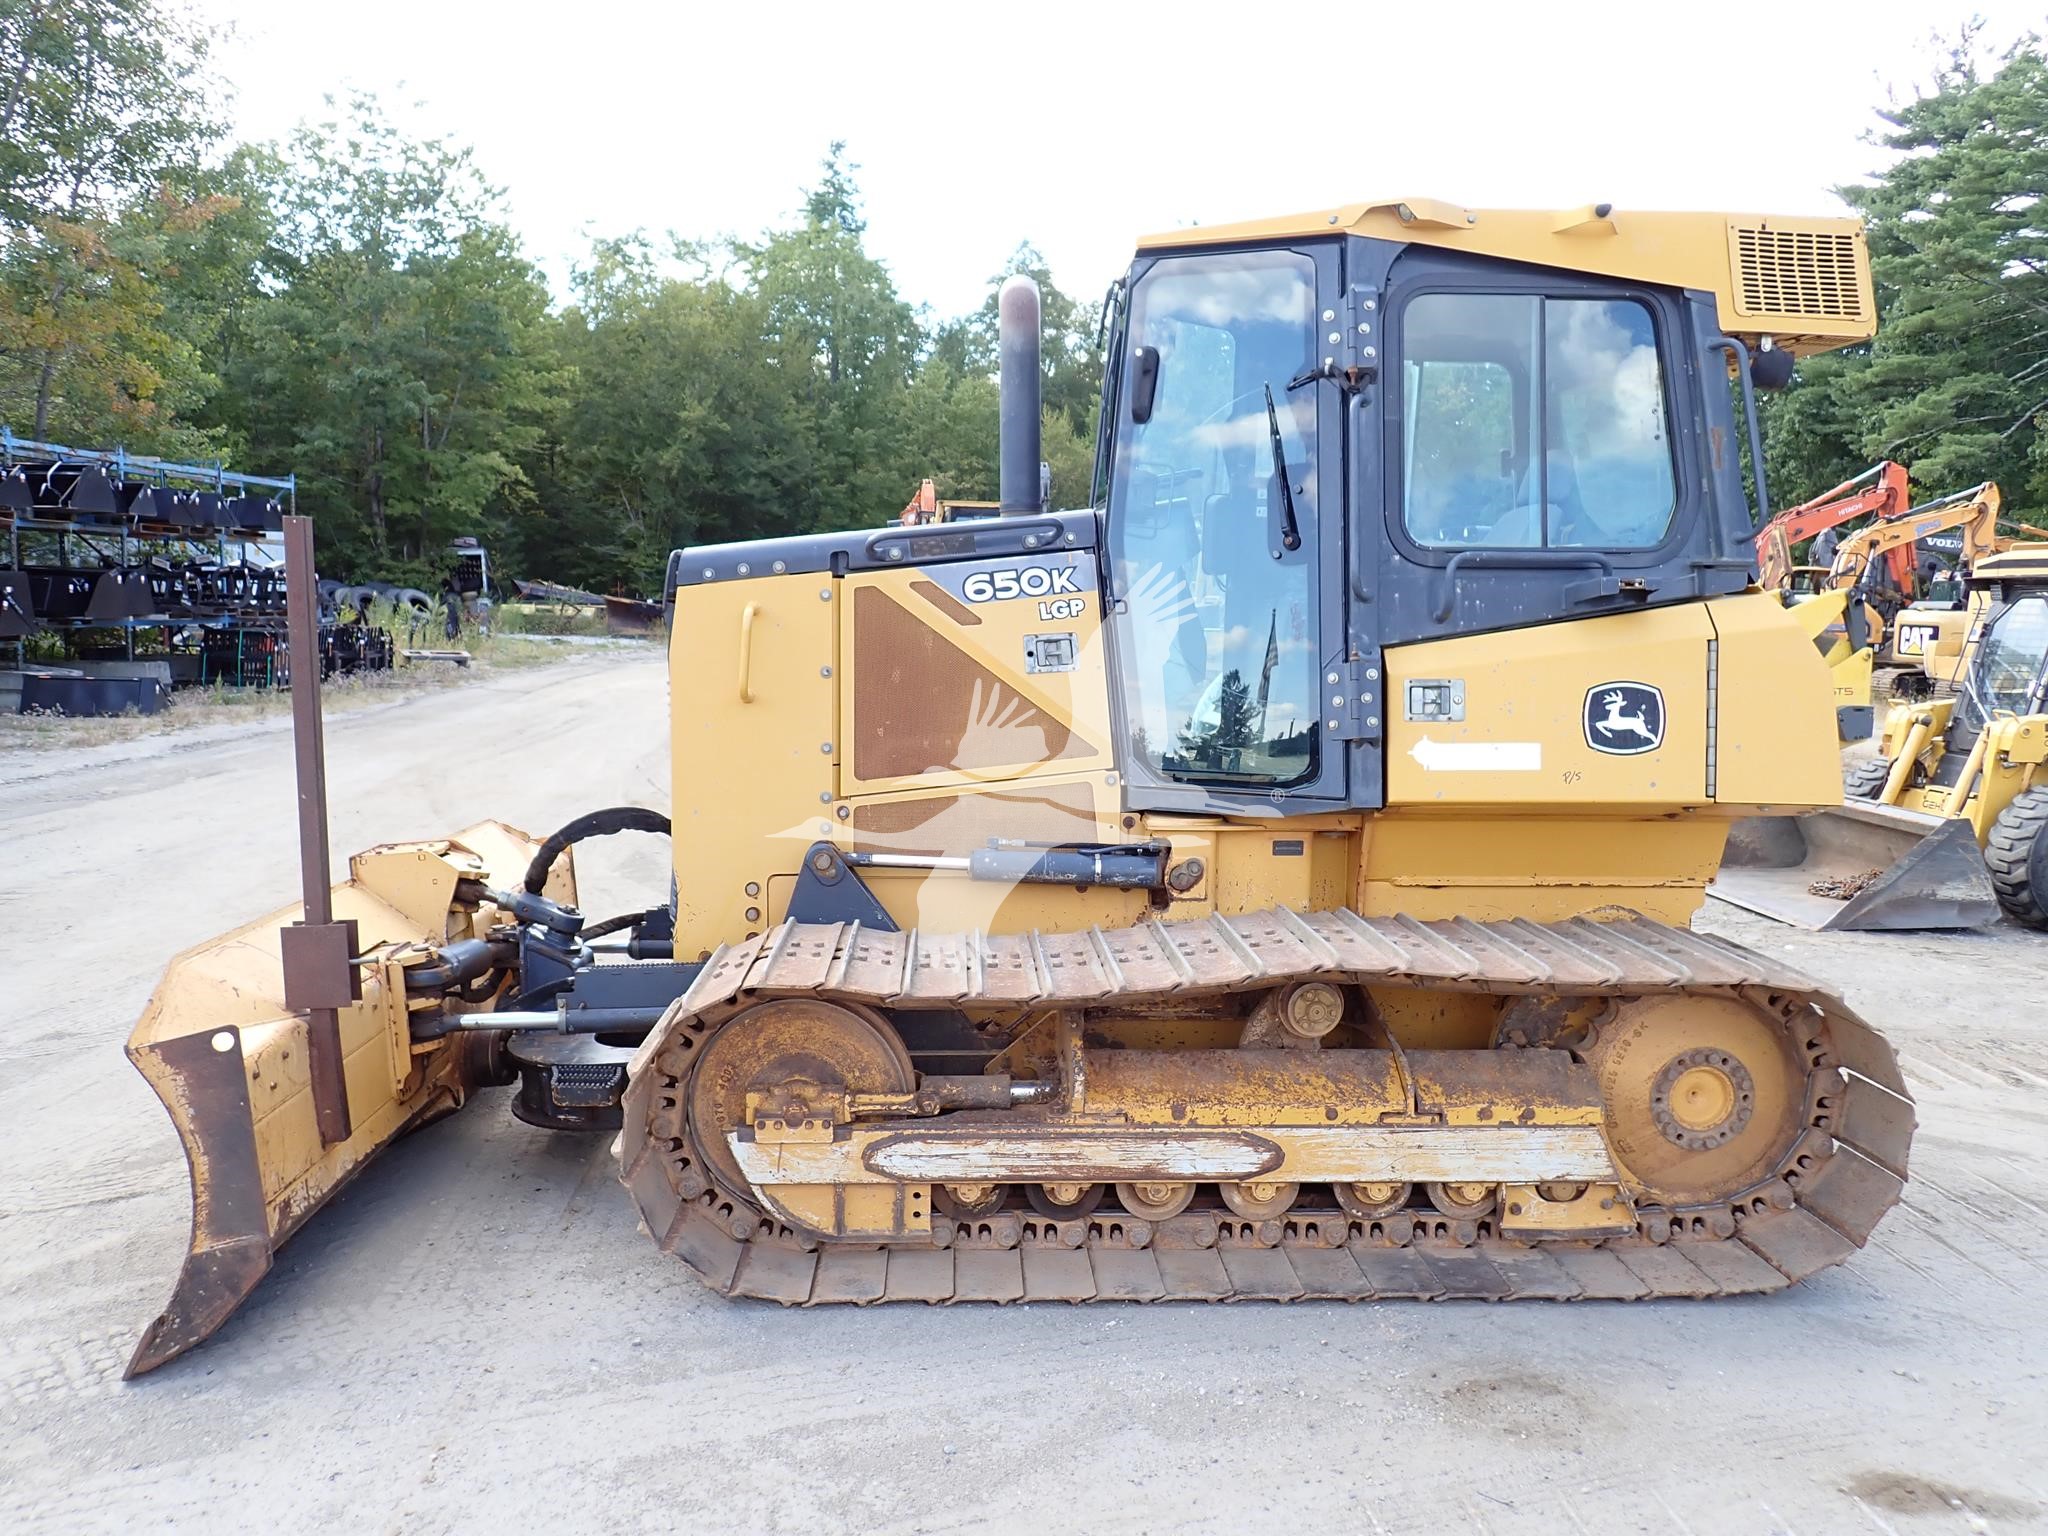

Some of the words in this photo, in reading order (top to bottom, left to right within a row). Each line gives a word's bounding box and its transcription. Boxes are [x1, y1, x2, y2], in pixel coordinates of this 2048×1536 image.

[1838, 503, 1863, 516] HITACHI
[962, 566, 1083, 603] 650K
[1038, 598, 1086, 621] LGP
[1900, 626, 1934, 655] CAT
